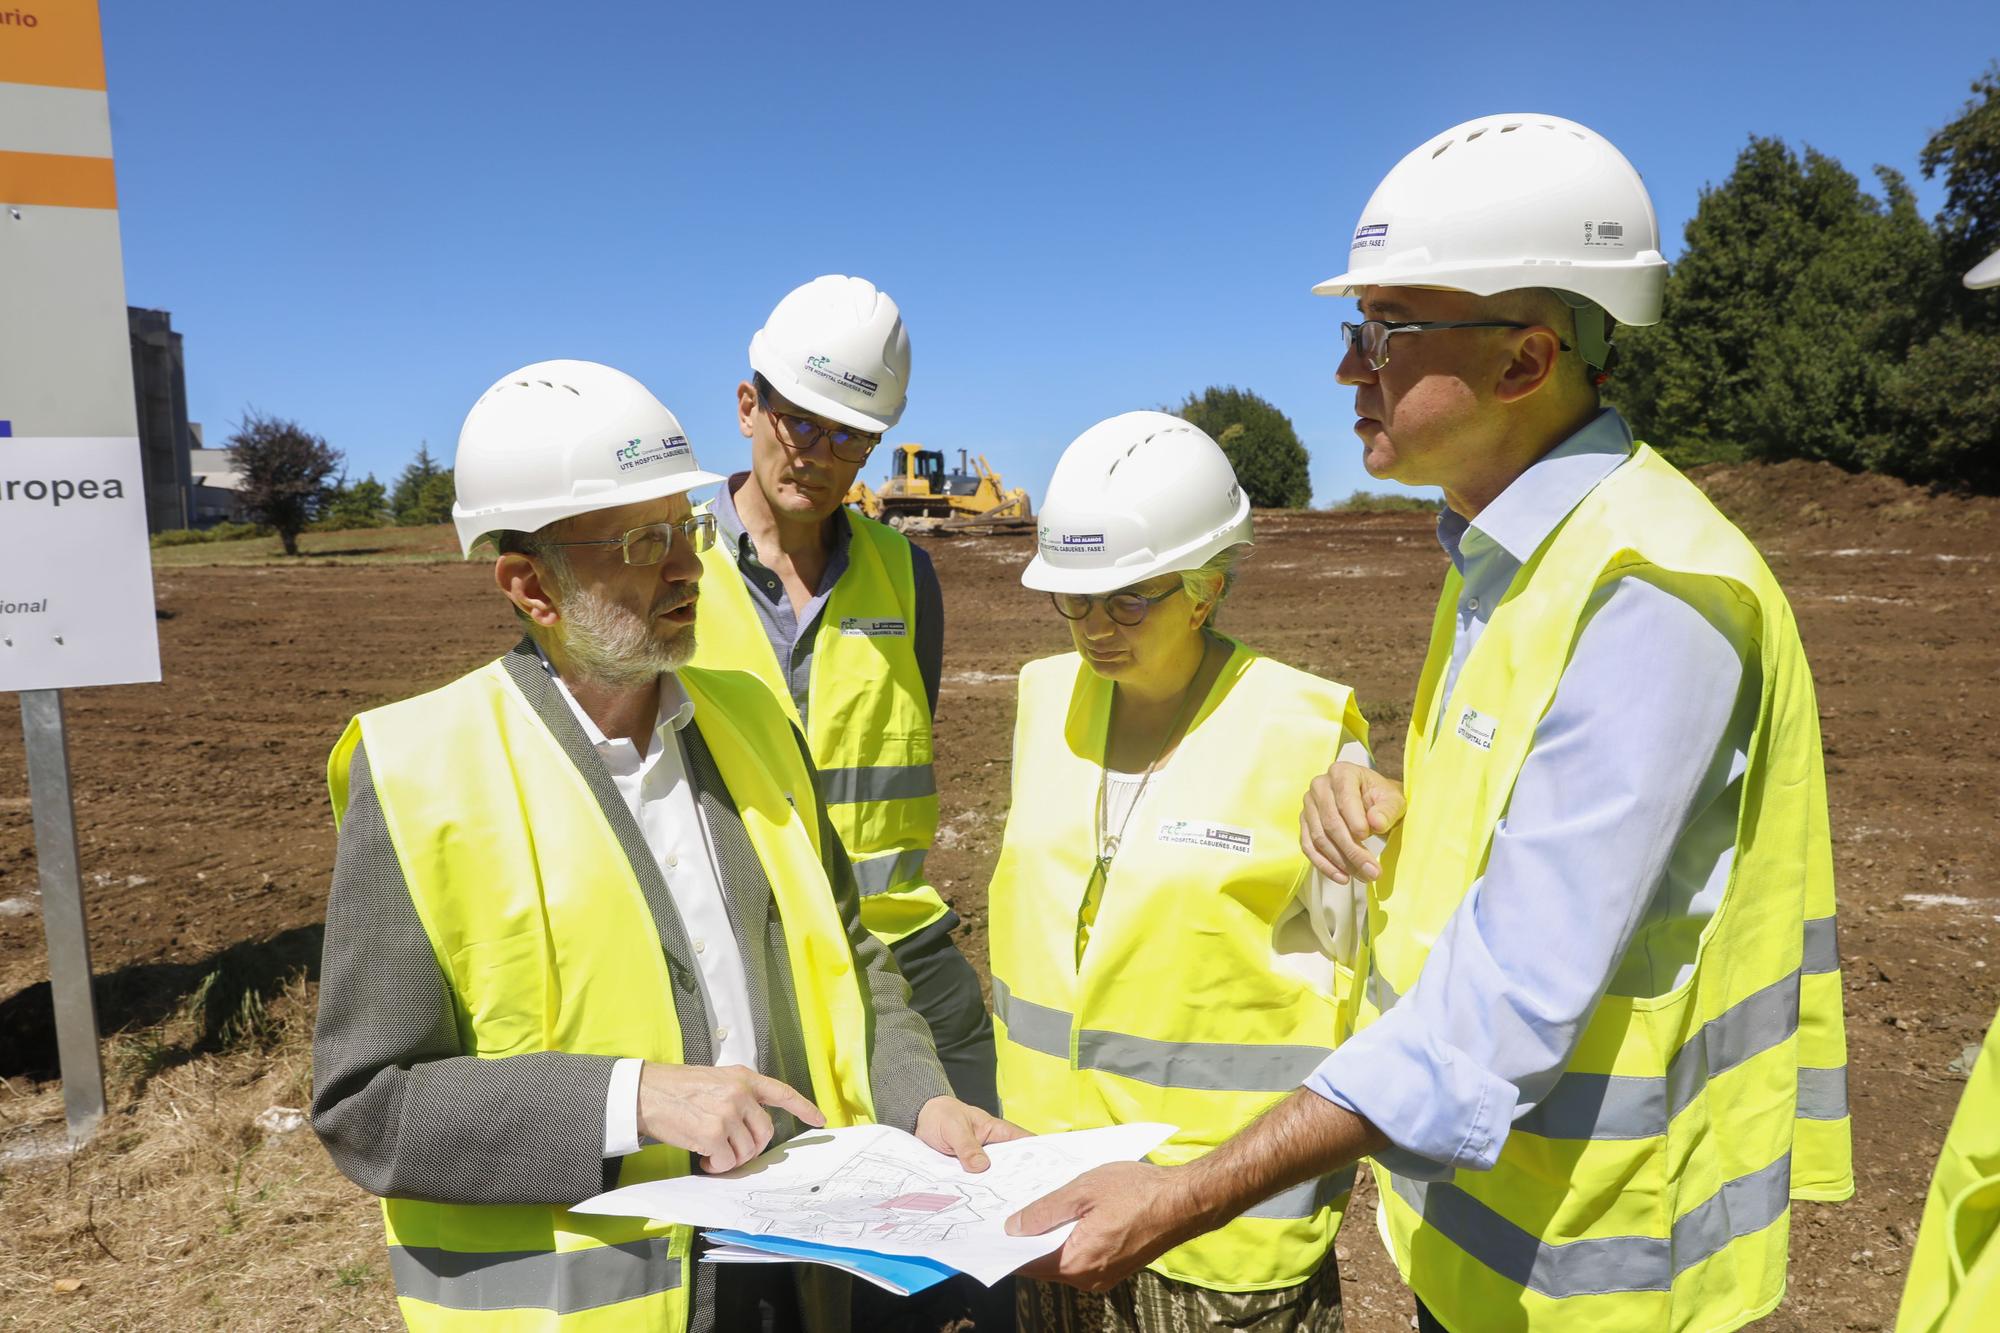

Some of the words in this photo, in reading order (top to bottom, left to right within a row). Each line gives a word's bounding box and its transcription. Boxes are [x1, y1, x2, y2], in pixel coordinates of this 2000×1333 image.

[0, 8, 38, 28] rio
[807, 356, 824, 369] FCC
[616, 445, 640, 462] FCC
[620, 462, 634, 471] UTE
[635, 453, 663, 467] HOSPITAL
[0, 479, 125, 507] ropea
